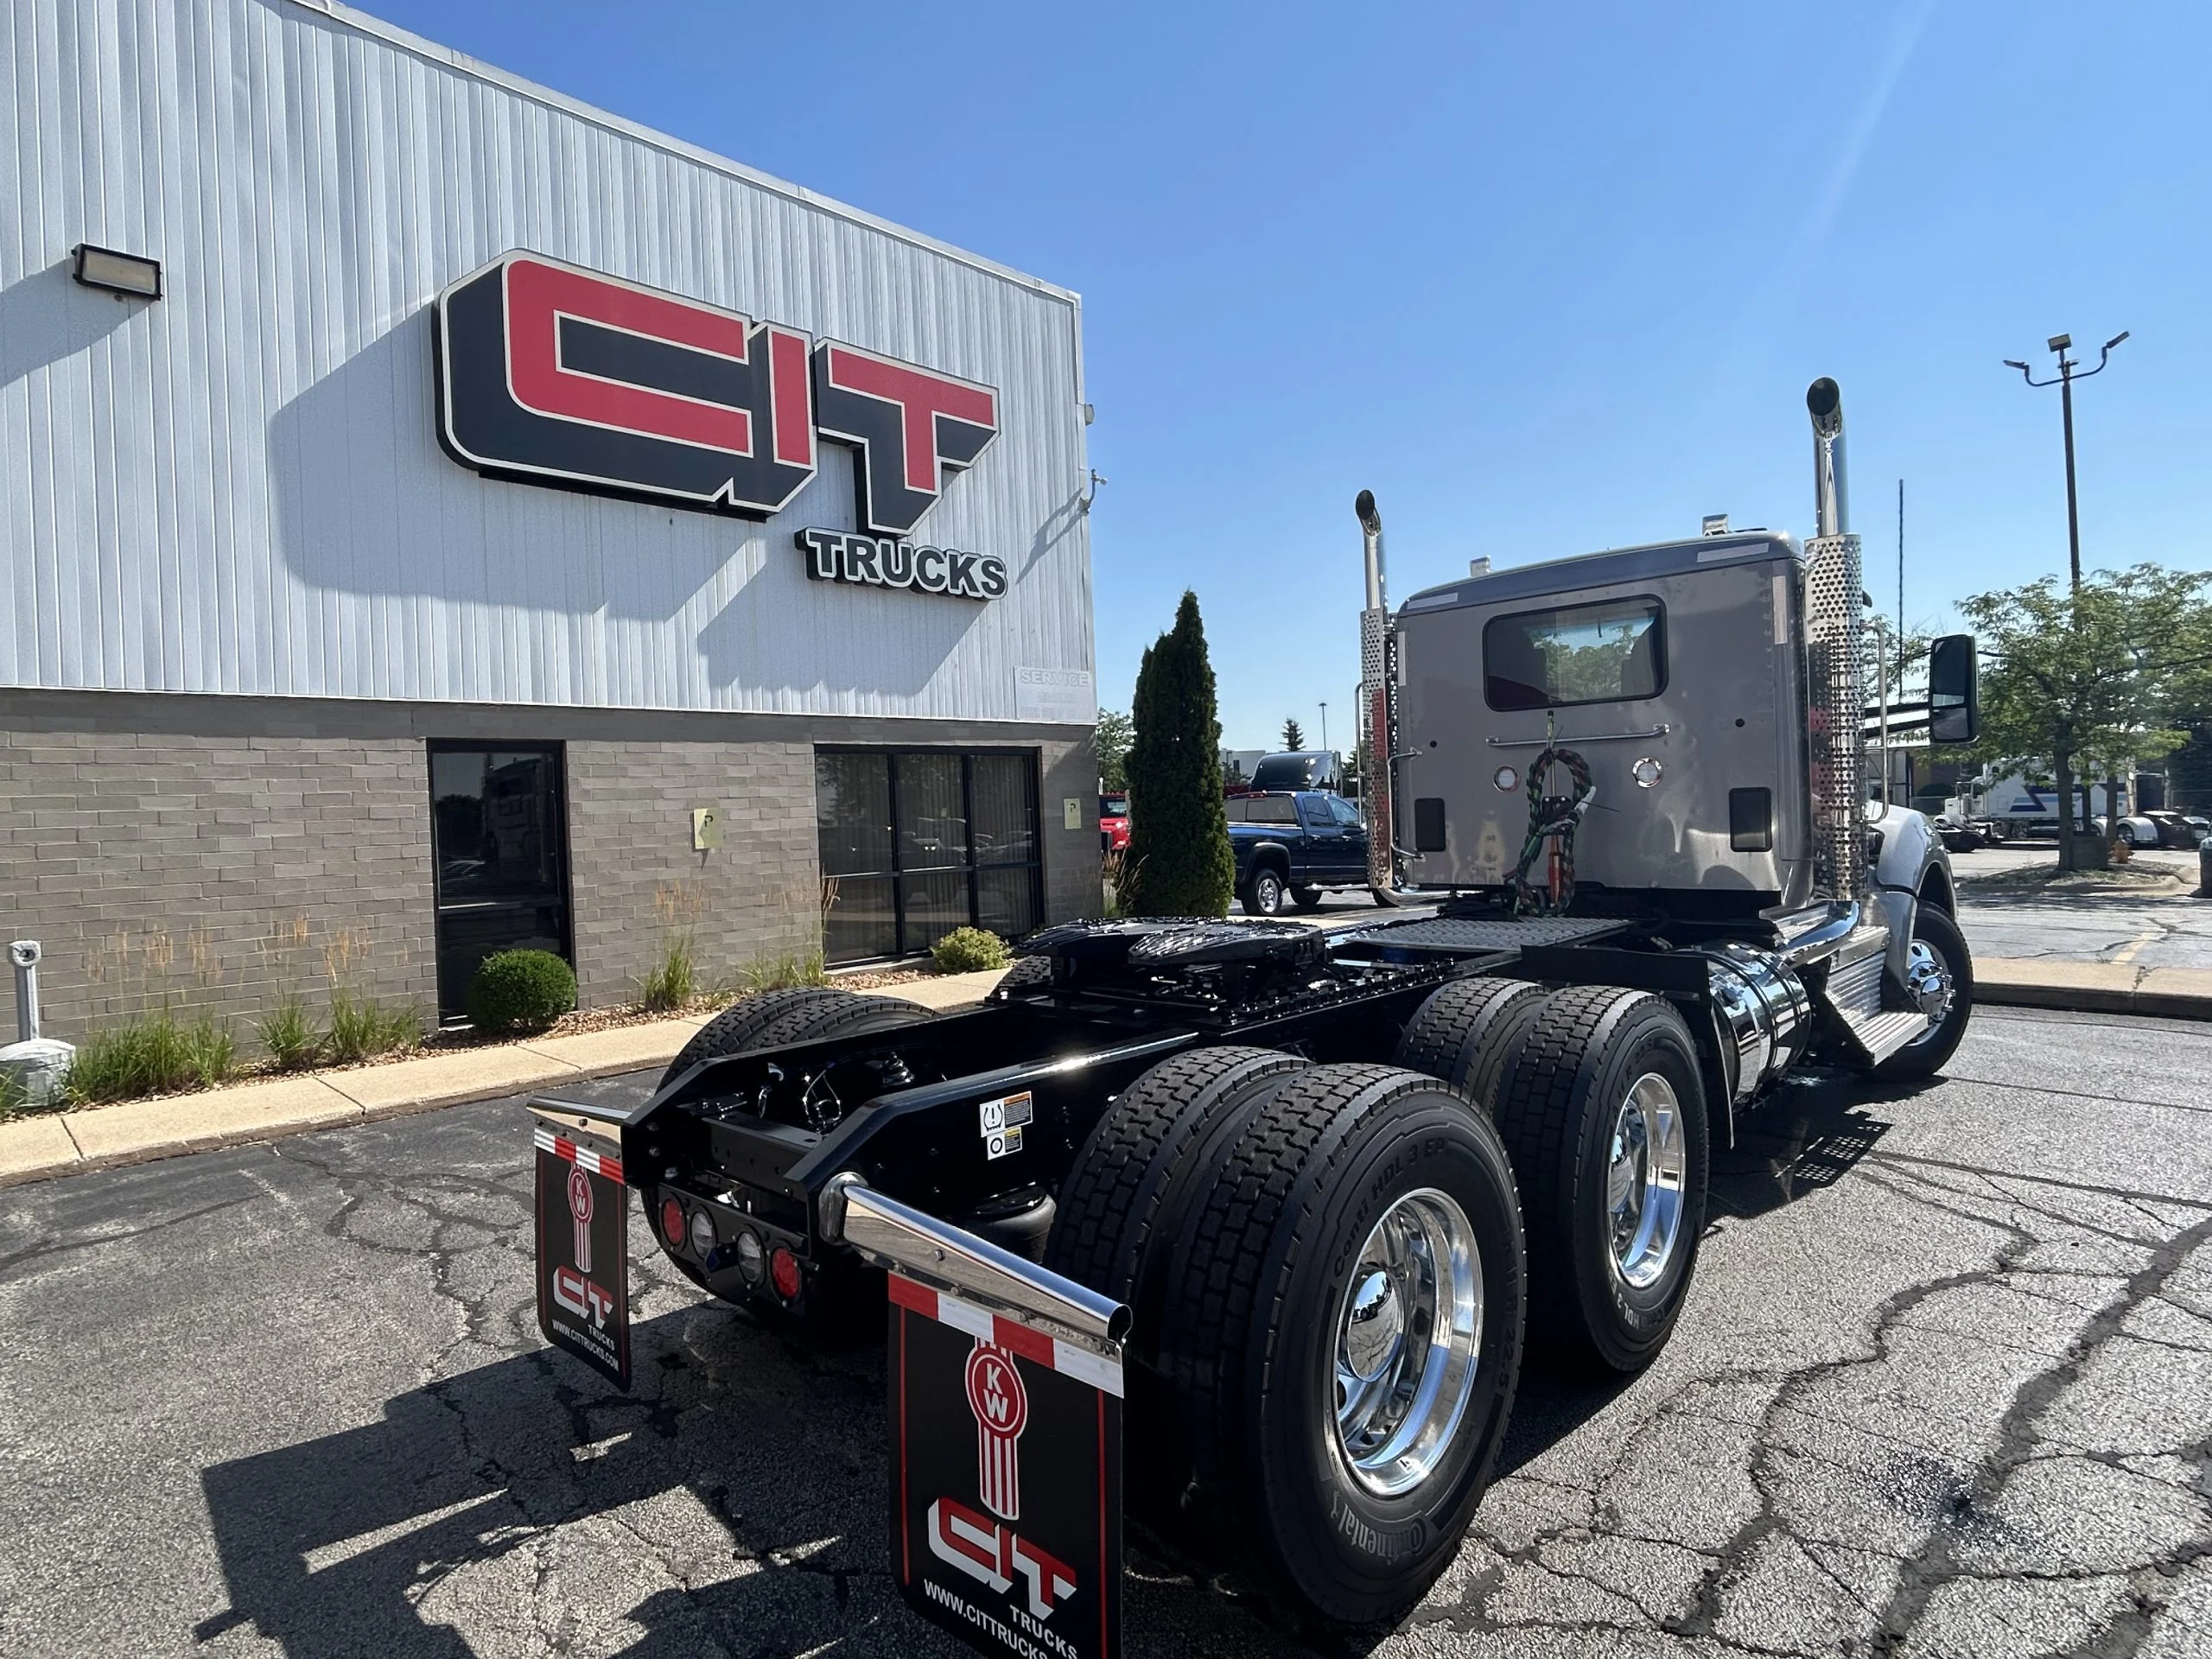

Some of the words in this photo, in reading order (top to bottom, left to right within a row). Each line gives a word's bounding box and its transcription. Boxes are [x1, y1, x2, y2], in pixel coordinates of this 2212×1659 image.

[439, 247, 1001, 537] CIT
[804, 527, 1008, 601] TRUCKS
[1020, 669, 1090, 688] SERVICE
[1371, 1157, 1404, 1203] HDL
[1408, 1144, 1419, 1166] 3
[553, 1265, 613, 1330] CIT
[552, 1319, 619, 1372] WWW.CITTRUCKS.COM
[588, 1324, 615, 1351] TRUCKS
[928, 1497, 1077, 1621] CIT
[1009, 1605, 1077, 1659] TRUCKS
